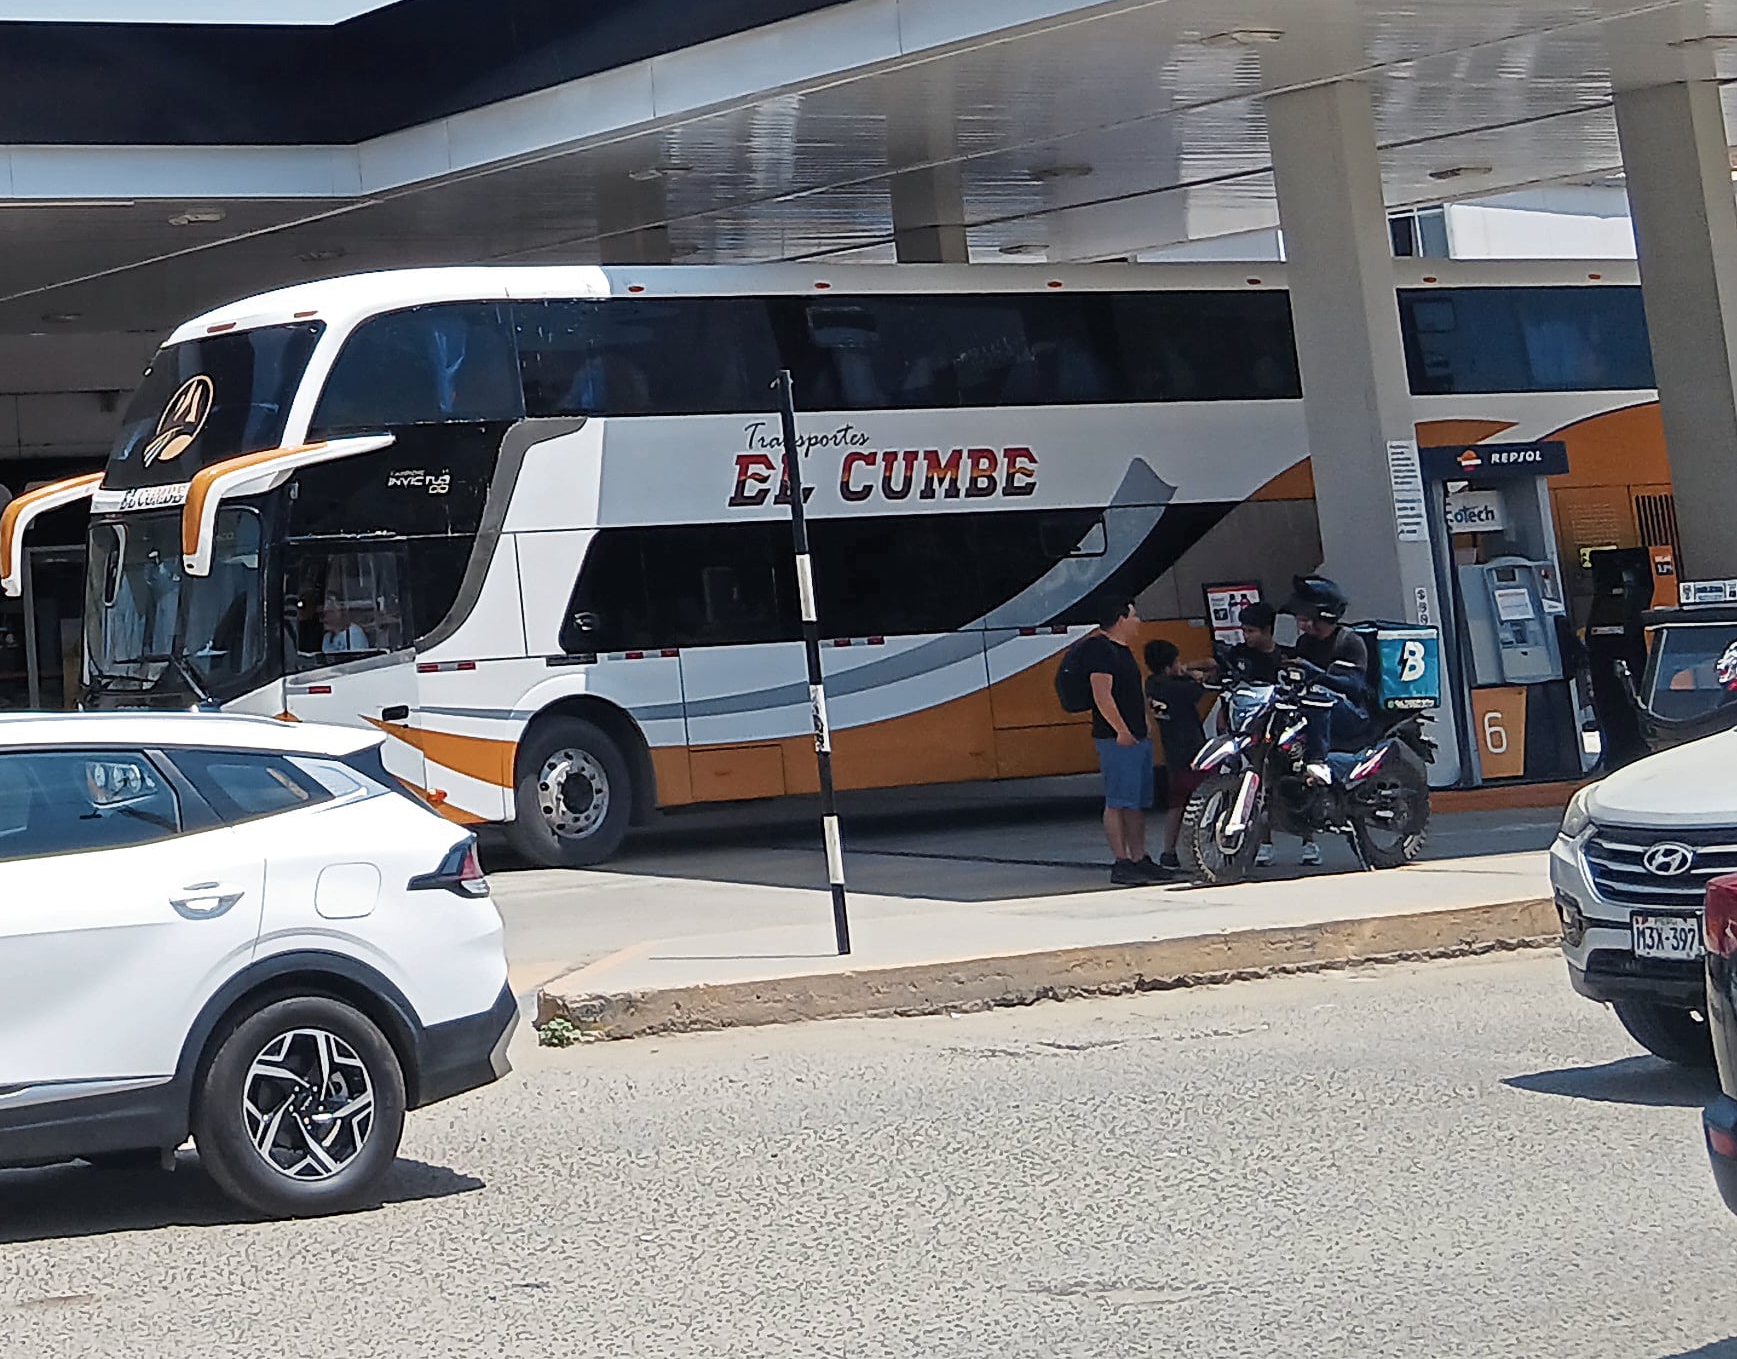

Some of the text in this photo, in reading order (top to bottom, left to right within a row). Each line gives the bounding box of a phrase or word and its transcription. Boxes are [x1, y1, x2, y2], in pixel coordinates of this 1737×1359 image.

[744, 422, 870, 457] Trasportes
[1490, 450, 1543, 465] REPSOL
[839, 447, 1039, 502] CUMBE
[1401, 641, 1425, 682] B
[1483, 711, 1508, 754] 6
